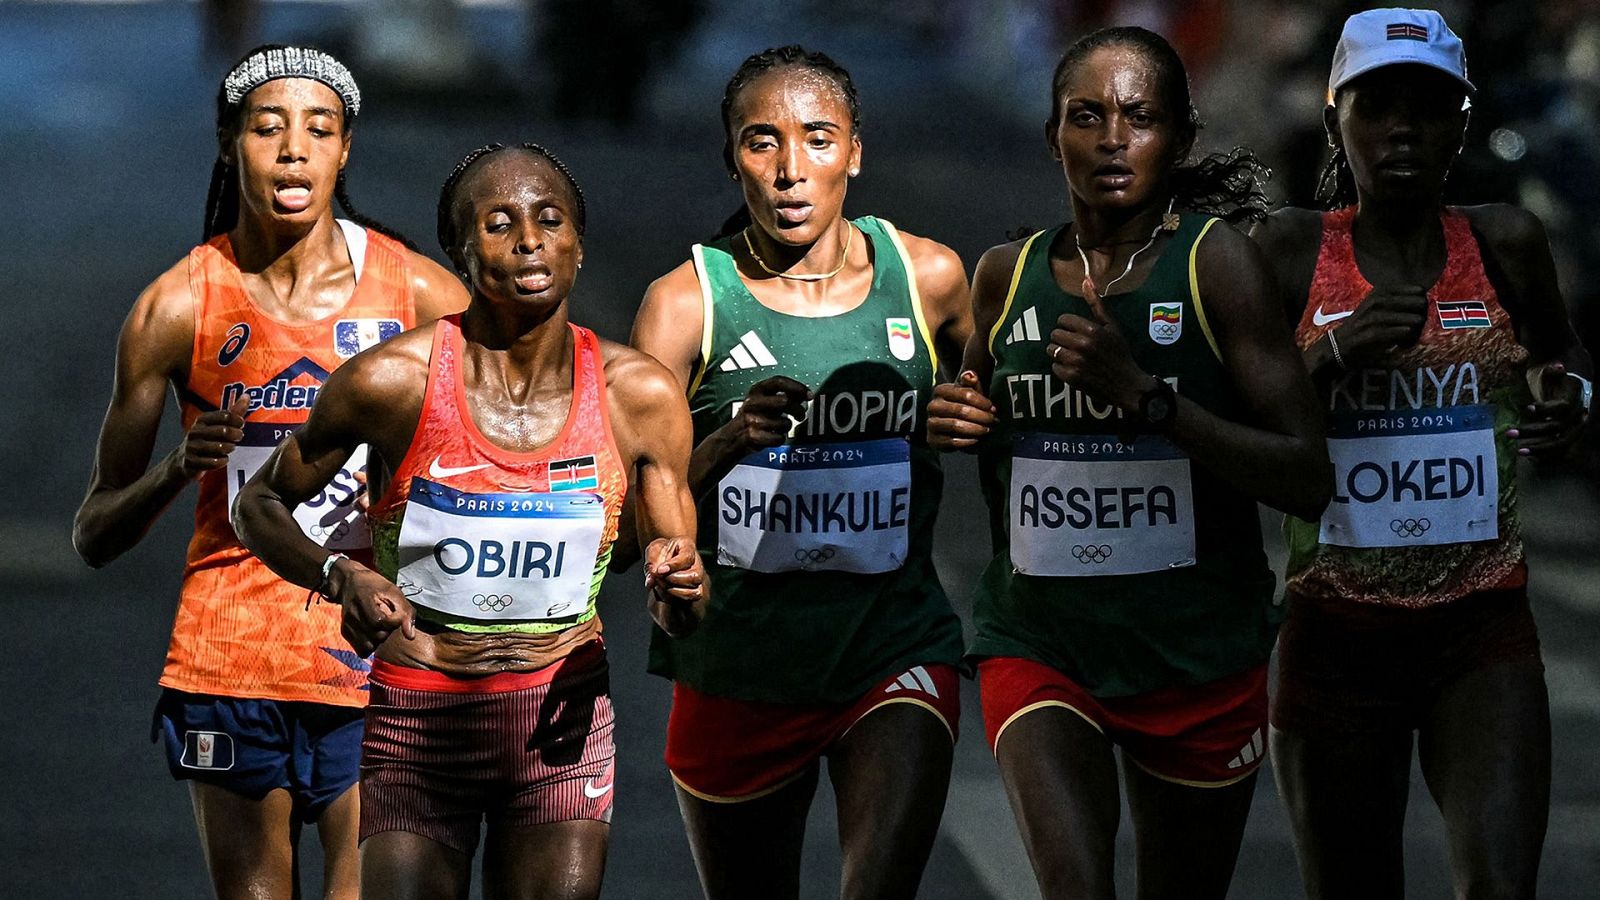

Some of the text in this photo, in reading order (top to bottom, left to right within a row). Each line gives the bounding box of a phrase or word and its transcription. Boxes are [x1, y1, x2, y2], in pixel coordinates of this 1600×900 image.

[1006, 374, 1178, 420] ETHIO
[1329, 361, 1479, 411] KENYA
[732, 390, 917, 438] HIOPIA
[1357, 414, 1454, 432] PARIS 2024
[768, 449, 864, 463] PARIS 2024
[1043, 441, 1135, 454] PARIS 2024
[1330, 455, 1485, 504] LOKEDI
[456, 497, 555, 512] PARIS 2024
[721, 485, 909, 534] SHANKULE
[1019, 484, 1178, 530] ASSEFA
[433, 537, 567, 579] OBIRI
